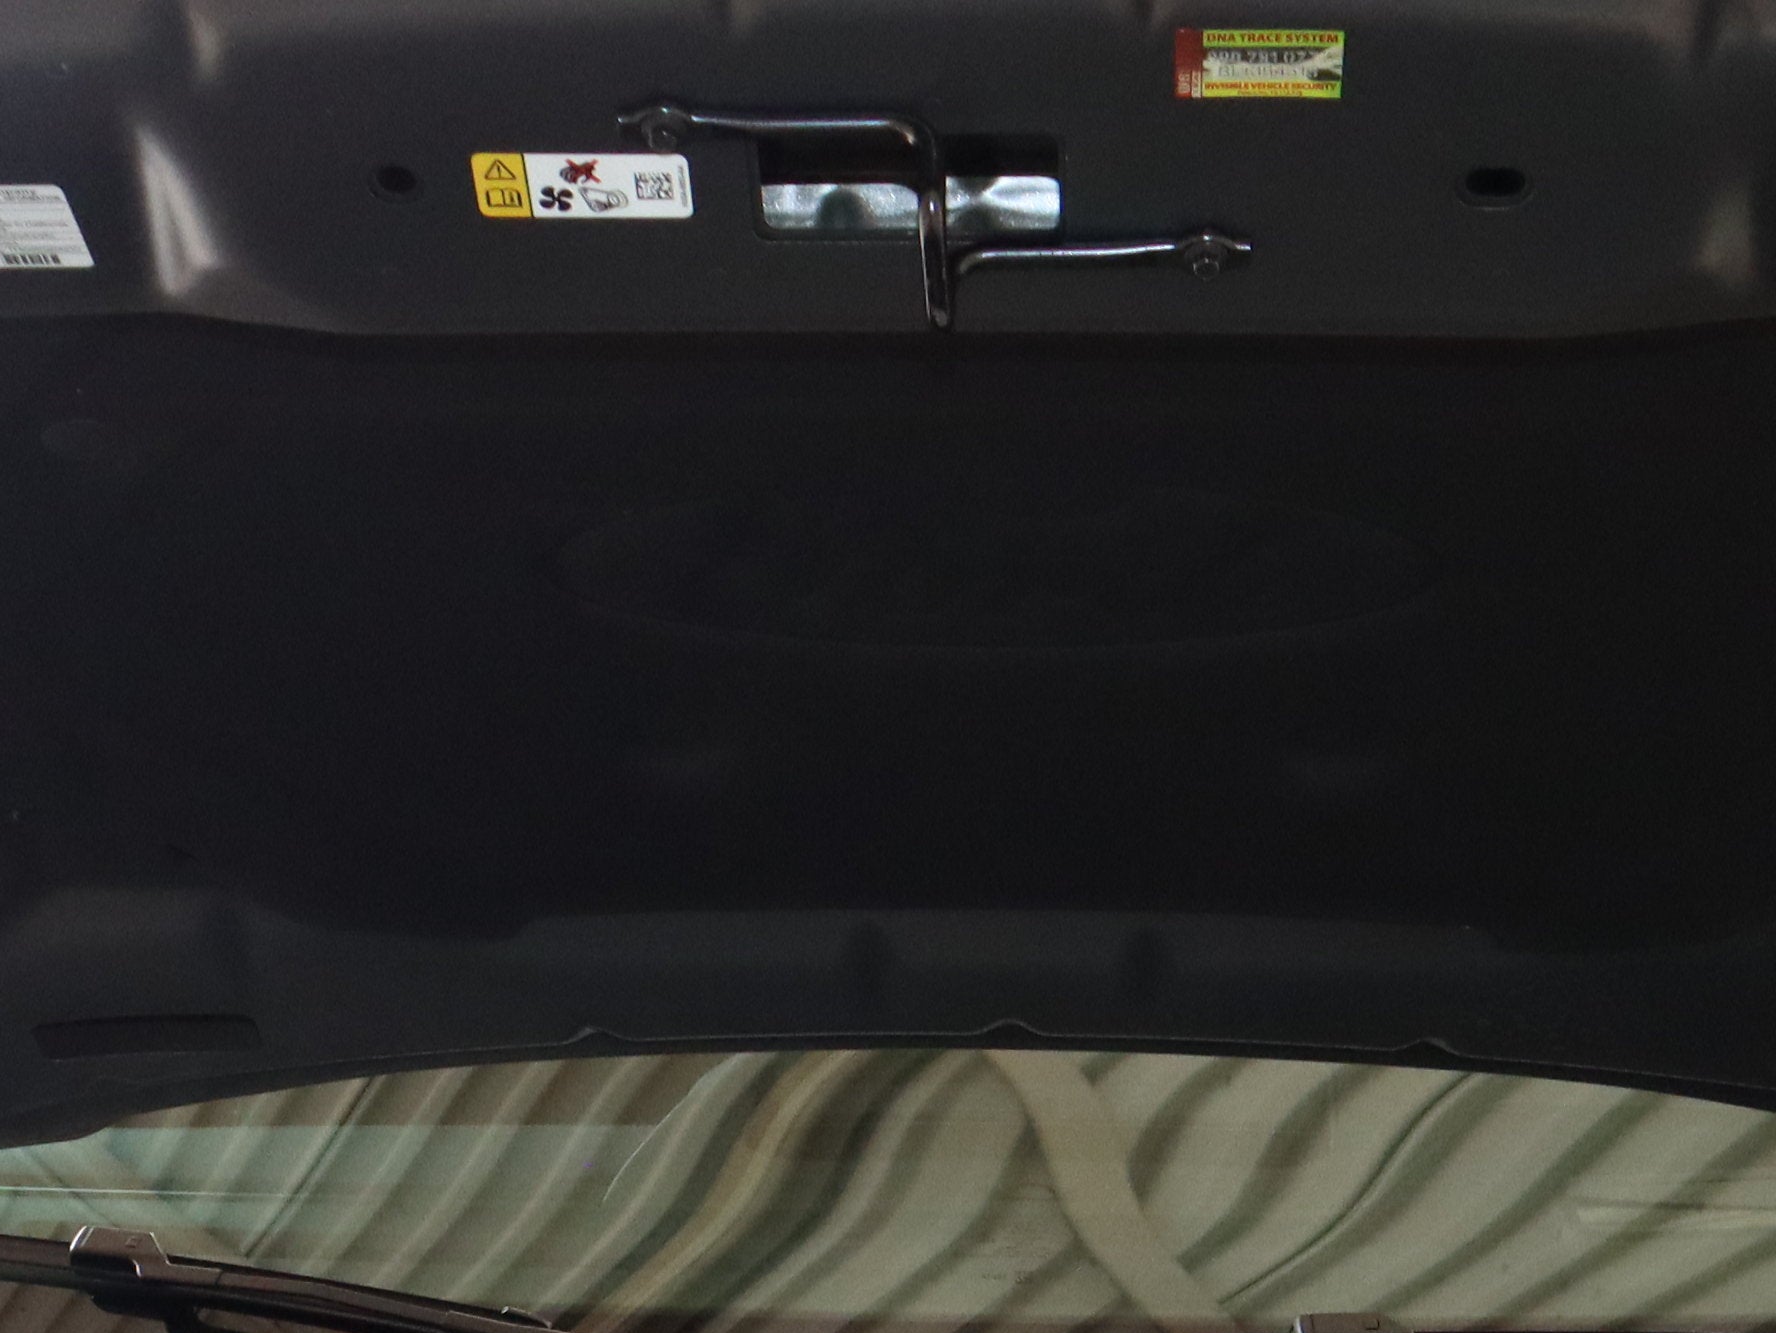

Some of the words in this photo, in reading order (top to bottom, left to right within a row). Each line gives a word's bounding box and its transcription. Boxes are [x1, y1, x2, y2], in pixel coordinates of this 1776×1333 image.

[1206, 33, 1236, 43] DNA
[1239, 33, 1283, 43] TRACE
[1286, 33, 1339, 43] SYSTEM
[1204, 82, 1249, 90] INVISIBLE
[1250, 82, 1289, 90] VEHICLE
[1291, 82, 1338, 90] SECURITY
